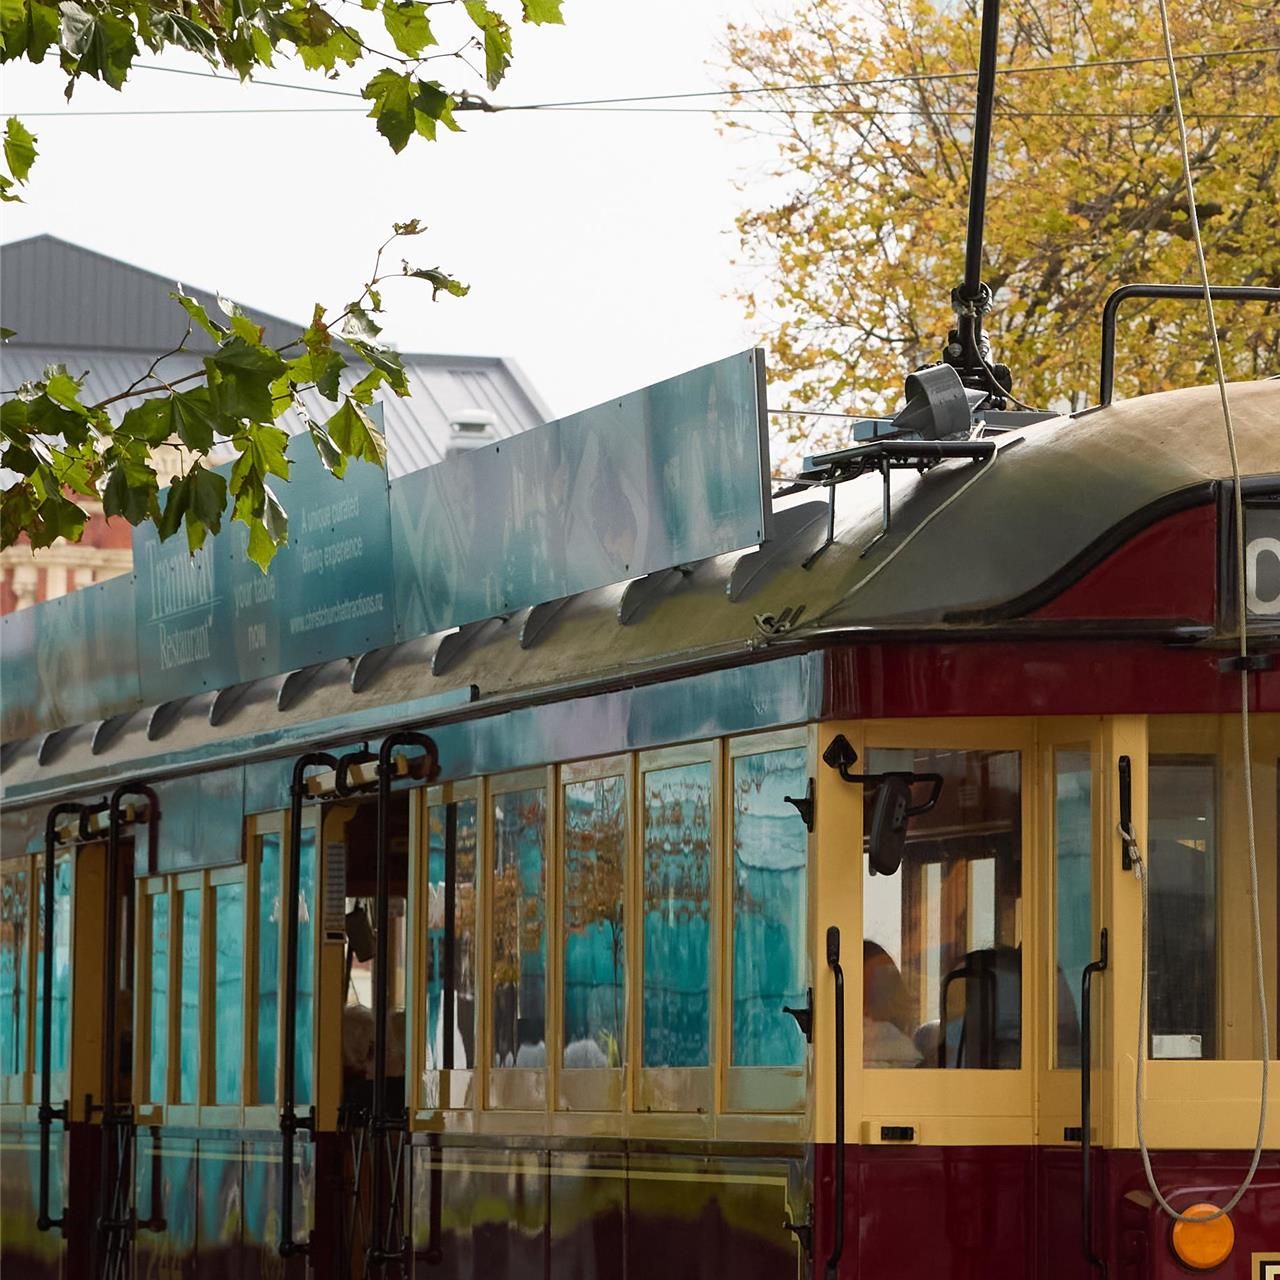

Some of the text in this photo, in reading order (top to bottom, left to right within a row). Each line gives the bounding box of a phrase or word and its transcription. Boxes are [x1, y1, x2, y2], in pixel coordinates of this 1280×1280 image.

[308, 504, 332, 532] unique
[332, 496, 359, 521] curated
[303, 536, 363, 574] dining experience
[145, 538, 215, 620] Tramway
[235, 573, 275, 617] your table
[159, 622, 211, 670] Restaurant
[248, 623, 267, 652] now
